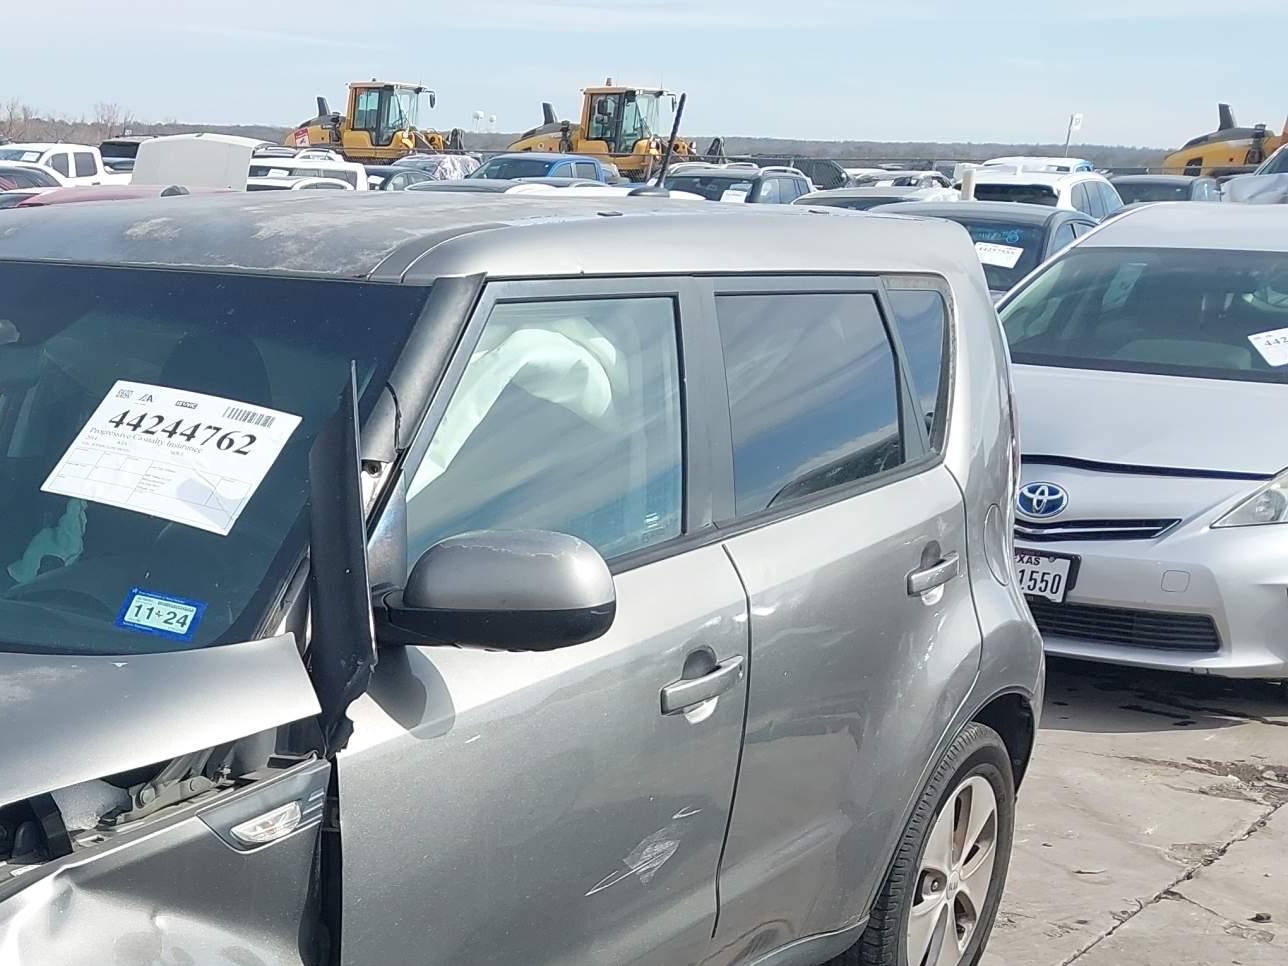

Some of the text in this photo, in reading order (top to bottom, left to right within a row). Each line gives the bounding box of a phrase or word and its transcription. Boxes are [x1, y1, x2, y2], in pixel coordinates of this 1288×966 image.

[89, 426, 132, 440] Progressive
[132, 432, 165, 447] Casualty
[166, 440, 202, 454] Insurance
[108, 409, 258, 456] 44244762
[1015, 552, 1041, 566] XAS
[1018, 569, 1062, 595] 1550
